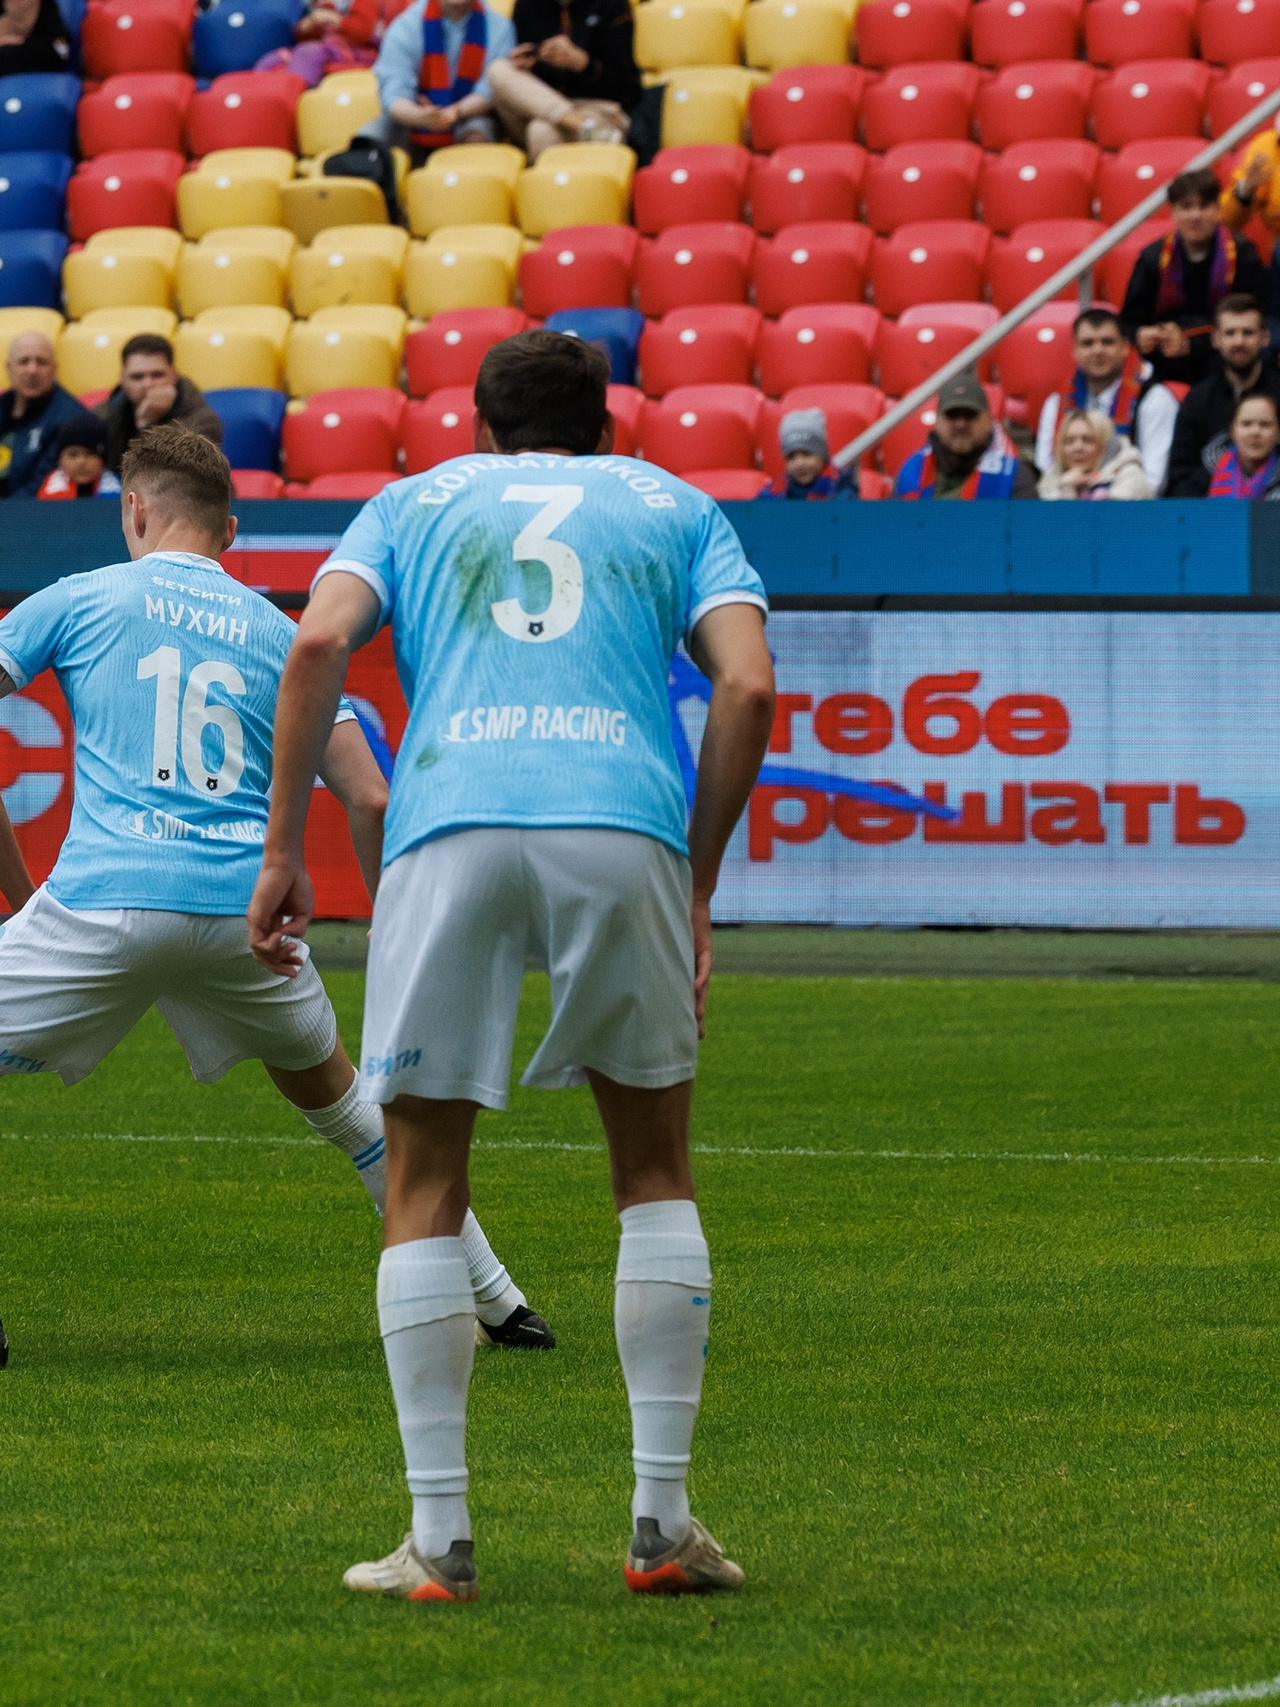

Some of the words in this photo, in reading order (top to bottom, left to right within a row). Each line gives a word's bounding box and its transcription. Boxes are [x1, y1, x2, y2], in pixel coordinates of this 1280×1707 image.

[417, 457, 678, 509] СОЛДАТЕНКОВ
[151, 575, 242, 606] БЕТСИТИ
[491, 484, 585, 644] 3
[144, 593, 249, 646] МУХИН
[136, 645, 247, 797] 16
[470, 705, 527, 742] SMP
[531, 706, 627, 747] RACING
[768, 670, 1071, 757] тебе
[747, 781, 1247, 863] решать
